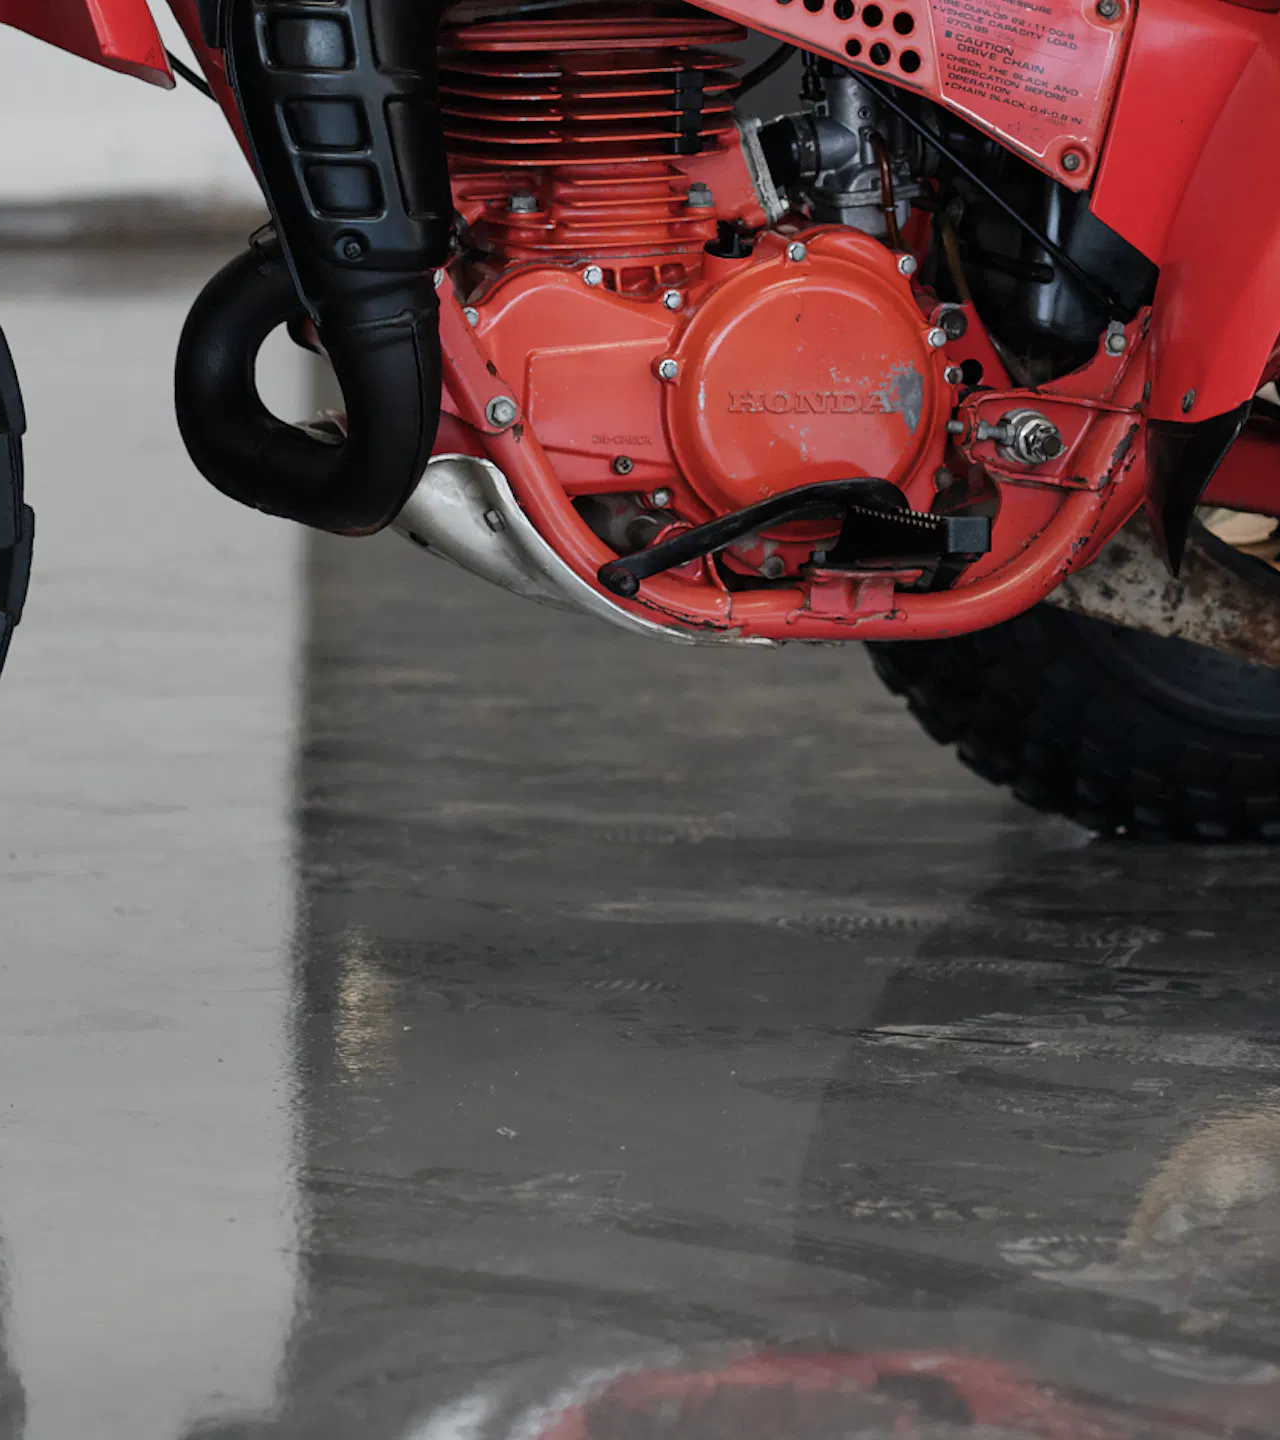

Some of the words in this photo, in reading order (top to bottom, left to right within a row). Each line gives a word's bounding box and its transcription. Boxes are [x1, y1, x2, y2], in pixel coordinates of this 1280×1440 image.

[939, 6, 984, 24] VEHICLE
[988, 20, 1043, 41] CAPACITY
[1047, 36, 1078, 51] LOAD
[955, 33, 1014, 57] CAUTION
[945, 54, 982, 69] CHECK
[988, 65, 1008, 77] THE
[1053, 84, 1079, 97] AND
[957, 43, 997, 61] DRIVE
[1002, 57, 1045, 75] CHAIN
[947, 63, 1020, 89] LUBRICATION
[1024, 85, 1067, 102] BEFORE
[948, 72, 1011, 96] OPERATION
[950, 82, 986, 98] CHAIN
[1071, 116, 1083, 125] IN
[727, 390, 897, 415] HONDA
